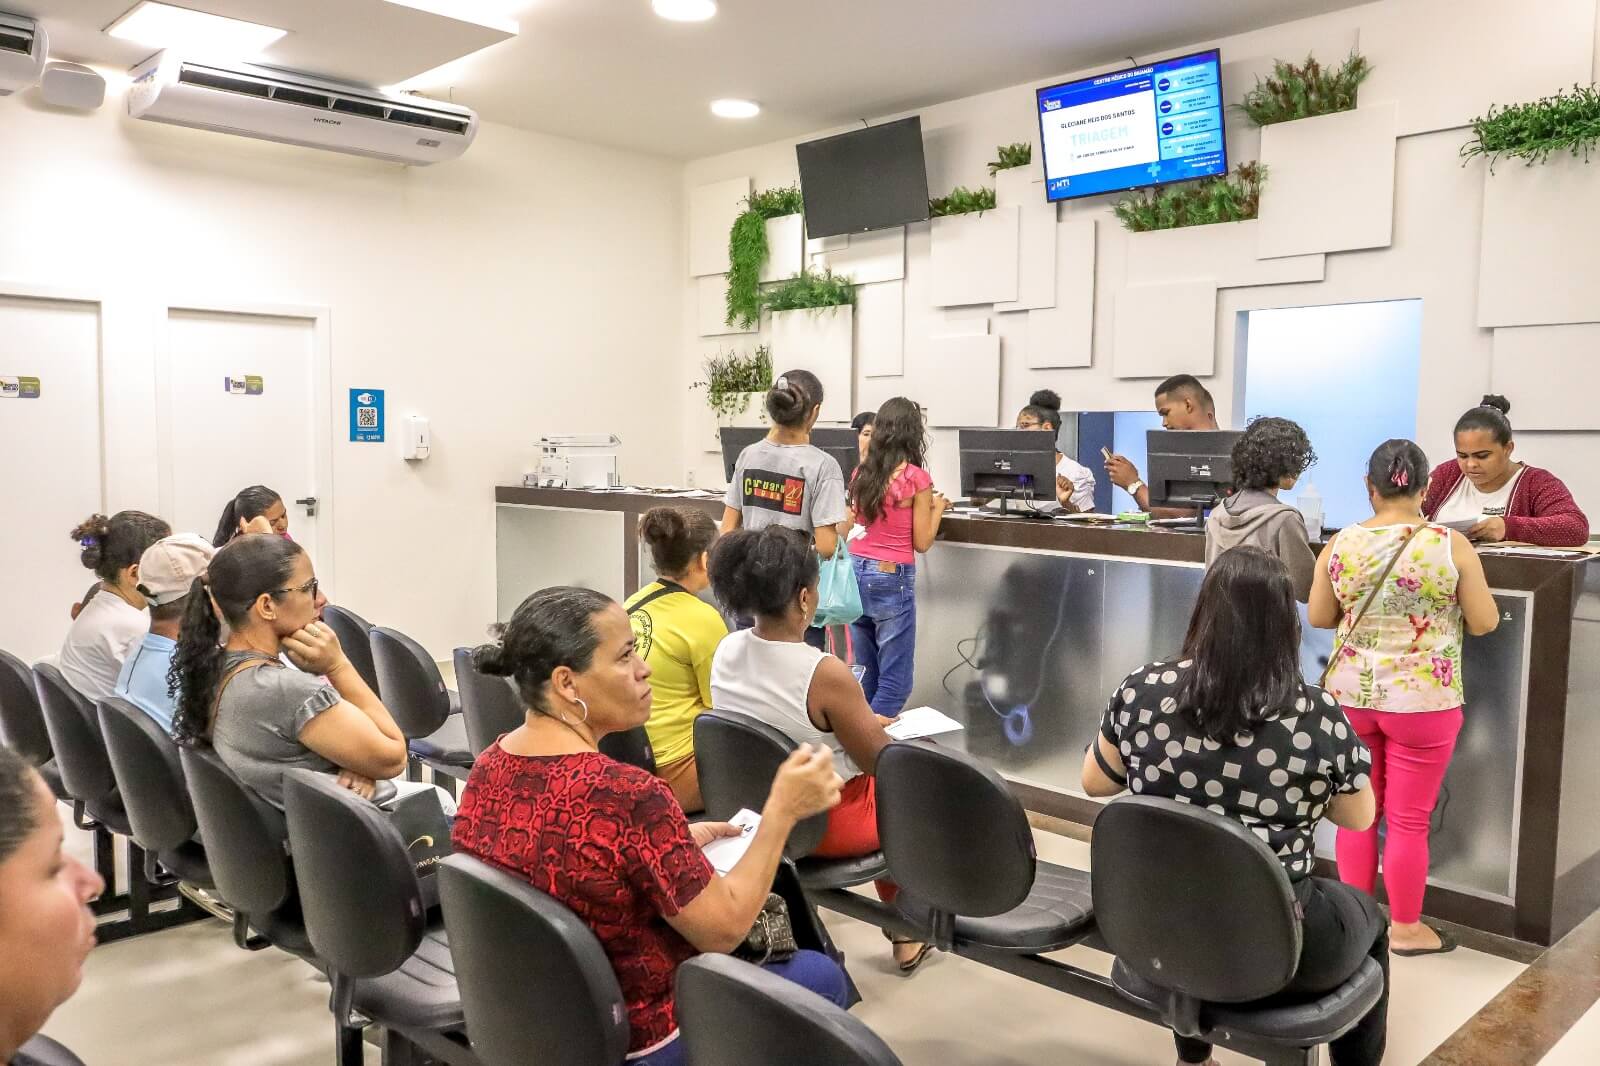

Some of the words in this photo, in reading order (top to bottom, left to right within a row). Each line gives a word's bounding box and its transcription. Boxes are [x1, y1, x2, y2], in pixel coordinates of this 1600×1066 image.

[1100, 113, 1112, 121] DOS
[1112, 109, 1135, 119] SANTOS
[1071, 125, 1129, 146] TRIAGEM
